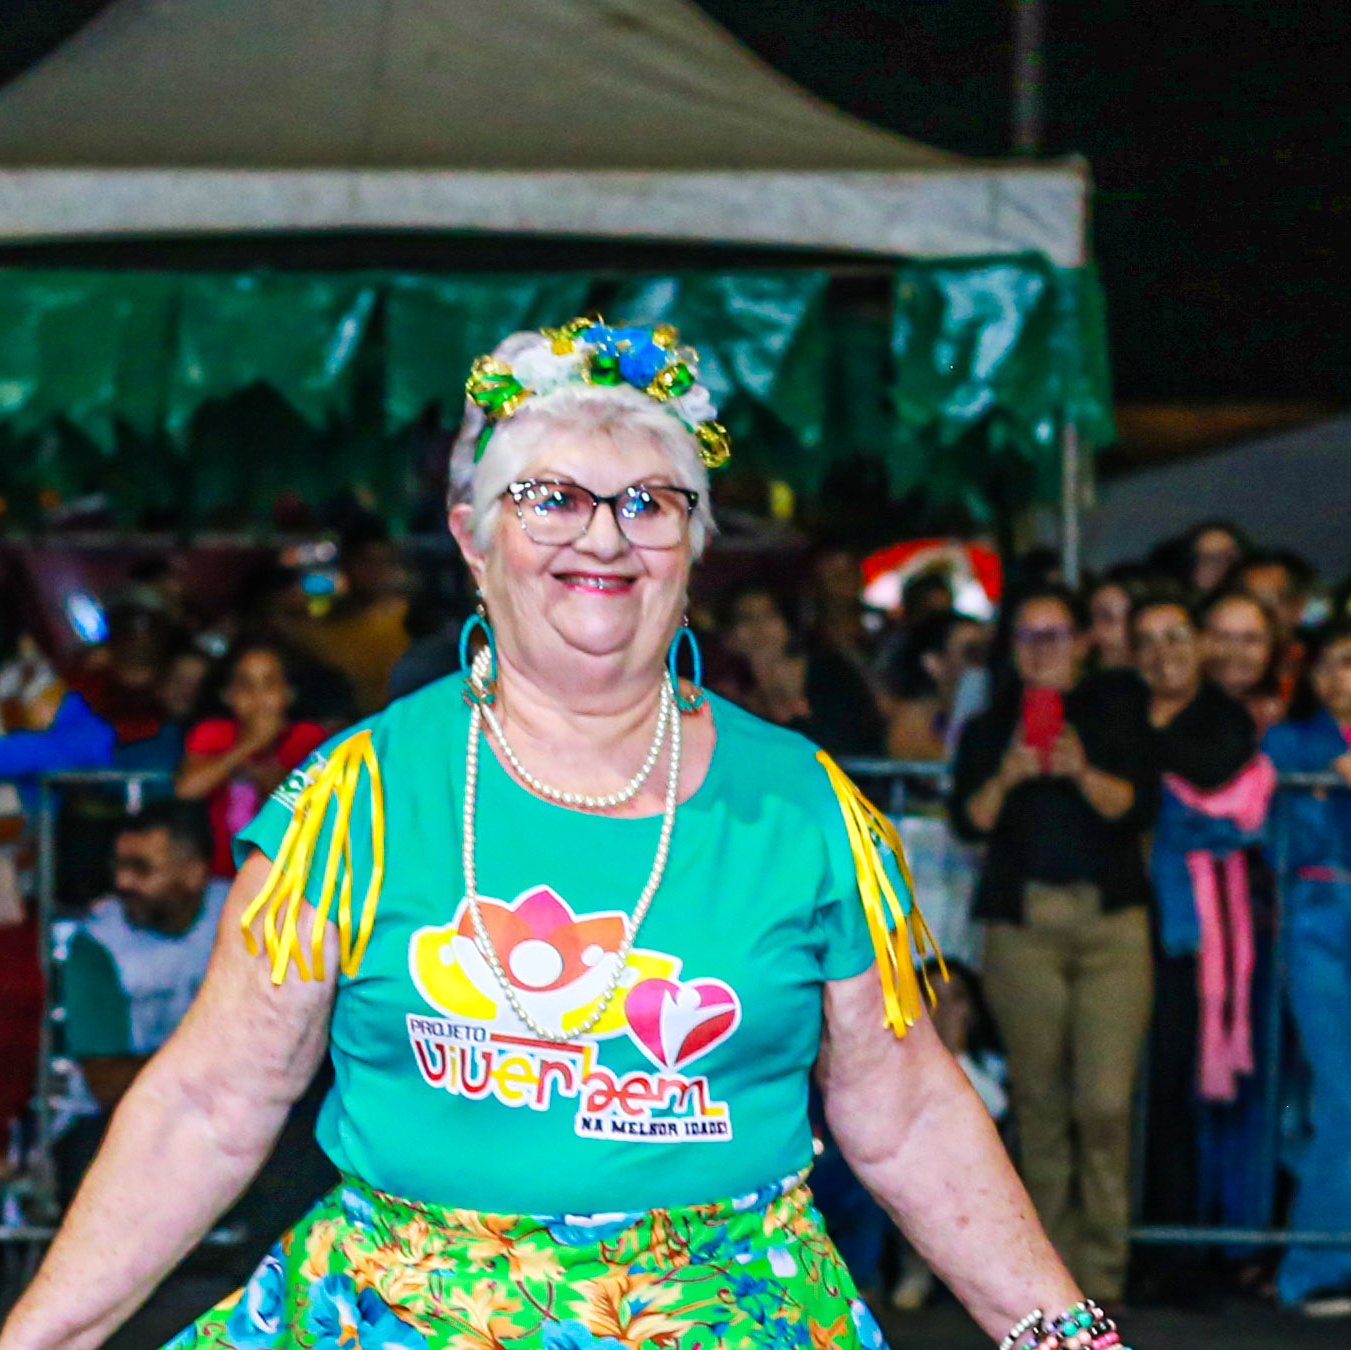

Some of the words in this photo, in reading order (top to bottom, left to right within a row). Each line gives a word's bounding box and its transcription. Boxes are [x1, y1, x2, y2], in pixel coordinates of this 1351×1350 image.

[410, 1018, 486, 1042] PROJETO
[581, 1117, 603, 1133] NA
[611, 1120, 679, 1136] MELHOR
